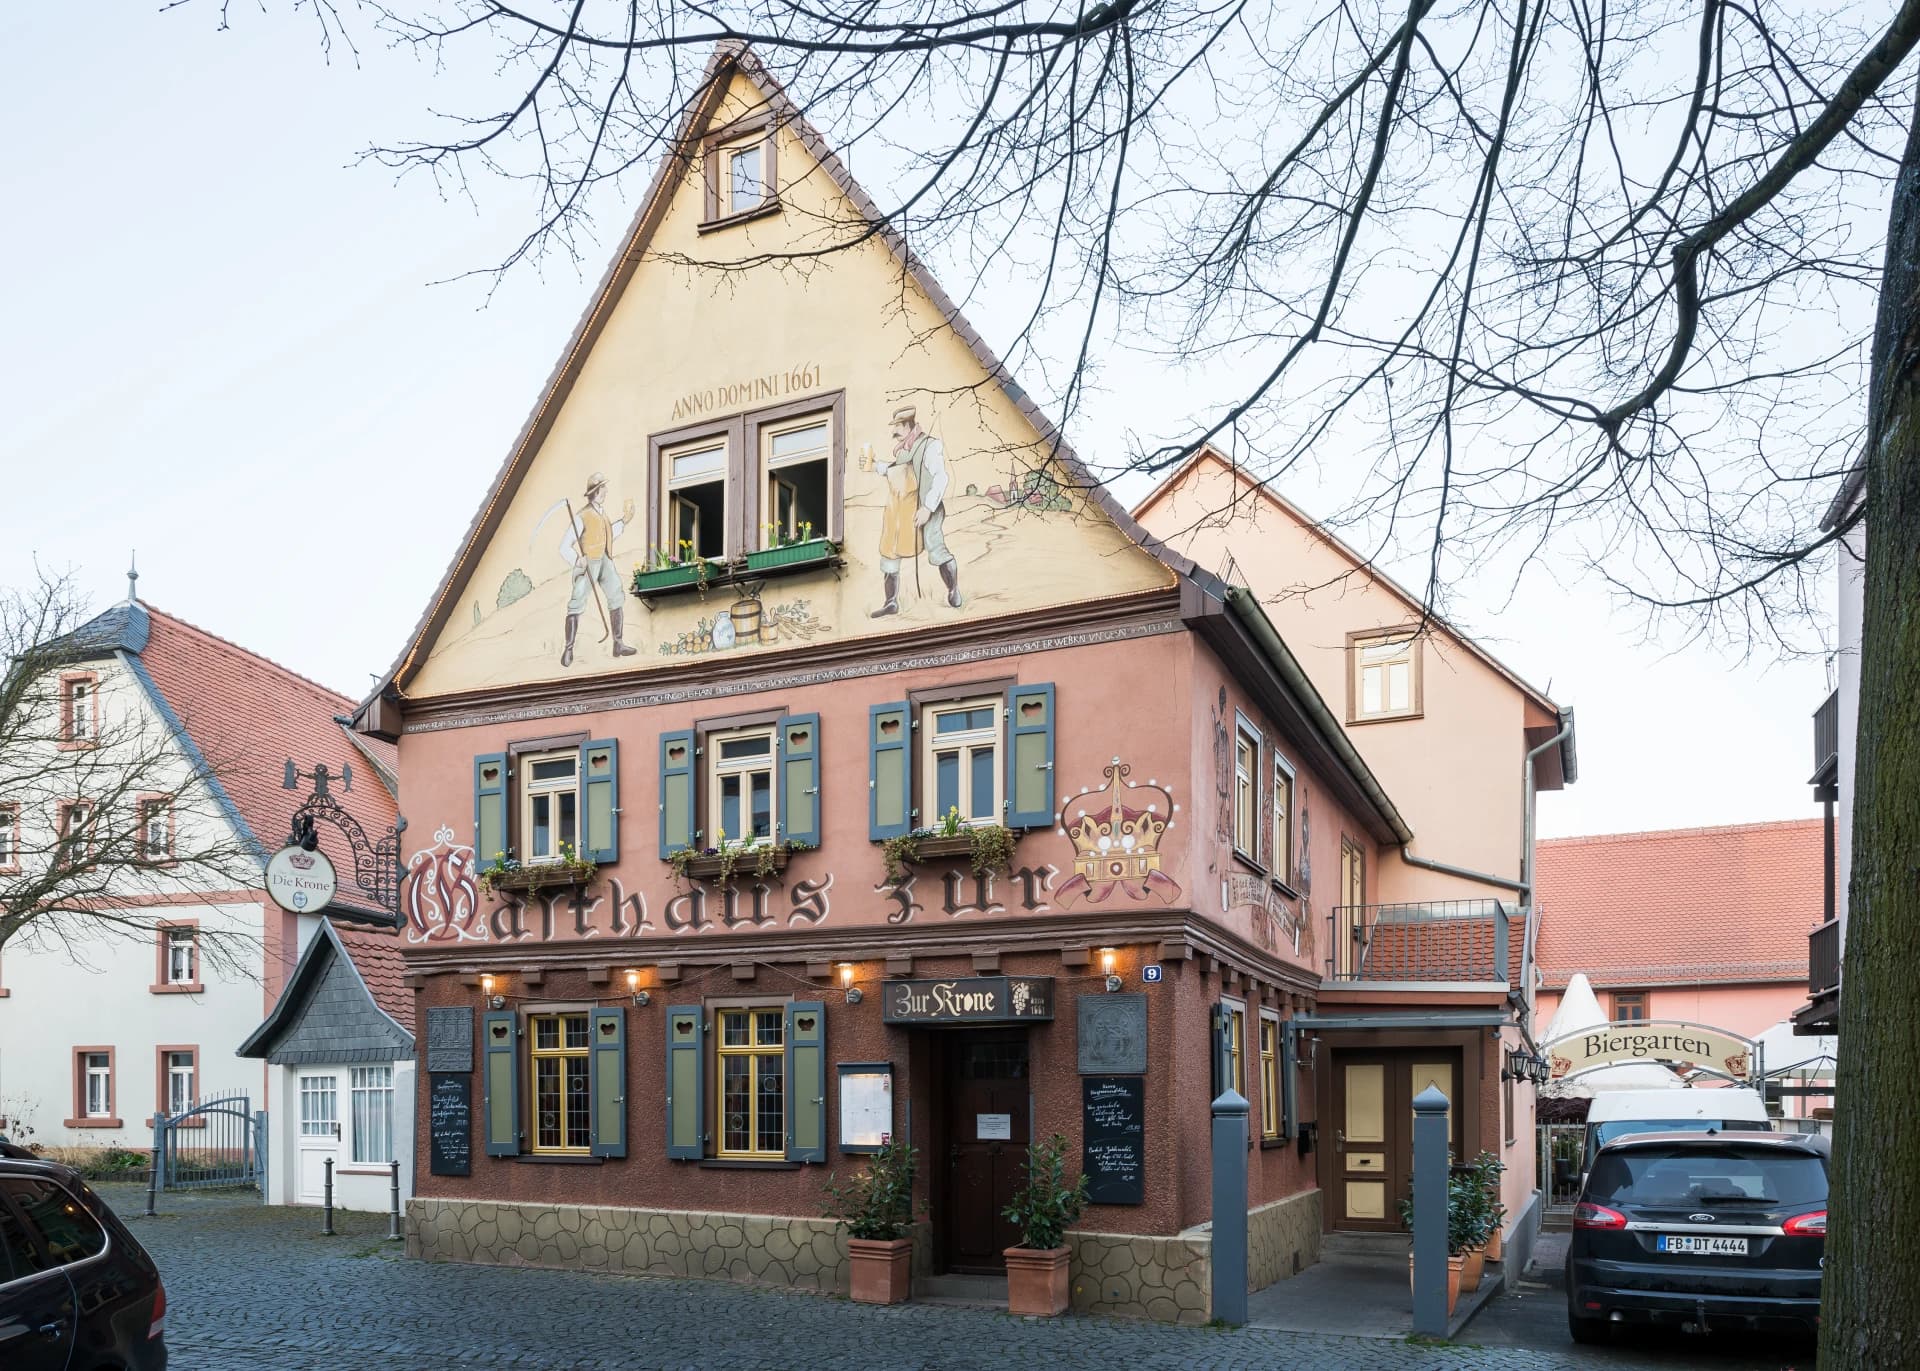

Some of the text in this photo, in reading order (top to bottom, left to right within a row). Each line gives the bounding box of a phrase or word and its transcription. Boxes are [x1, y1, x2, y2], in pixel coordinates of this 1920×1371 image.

[672, 361, 822, 421] ANNO DOMINI 1661
[273, 873, 293, 886] Die
[295, 877, 330, 891] Krone
[1147, 969, 1157, 980] 9
[893, 982, 996, 1019] Zur Krone
[1584, 1033, 1712, 1058] Biergarten
[1667, 1237, 1745, 1253] FB DT 4444
